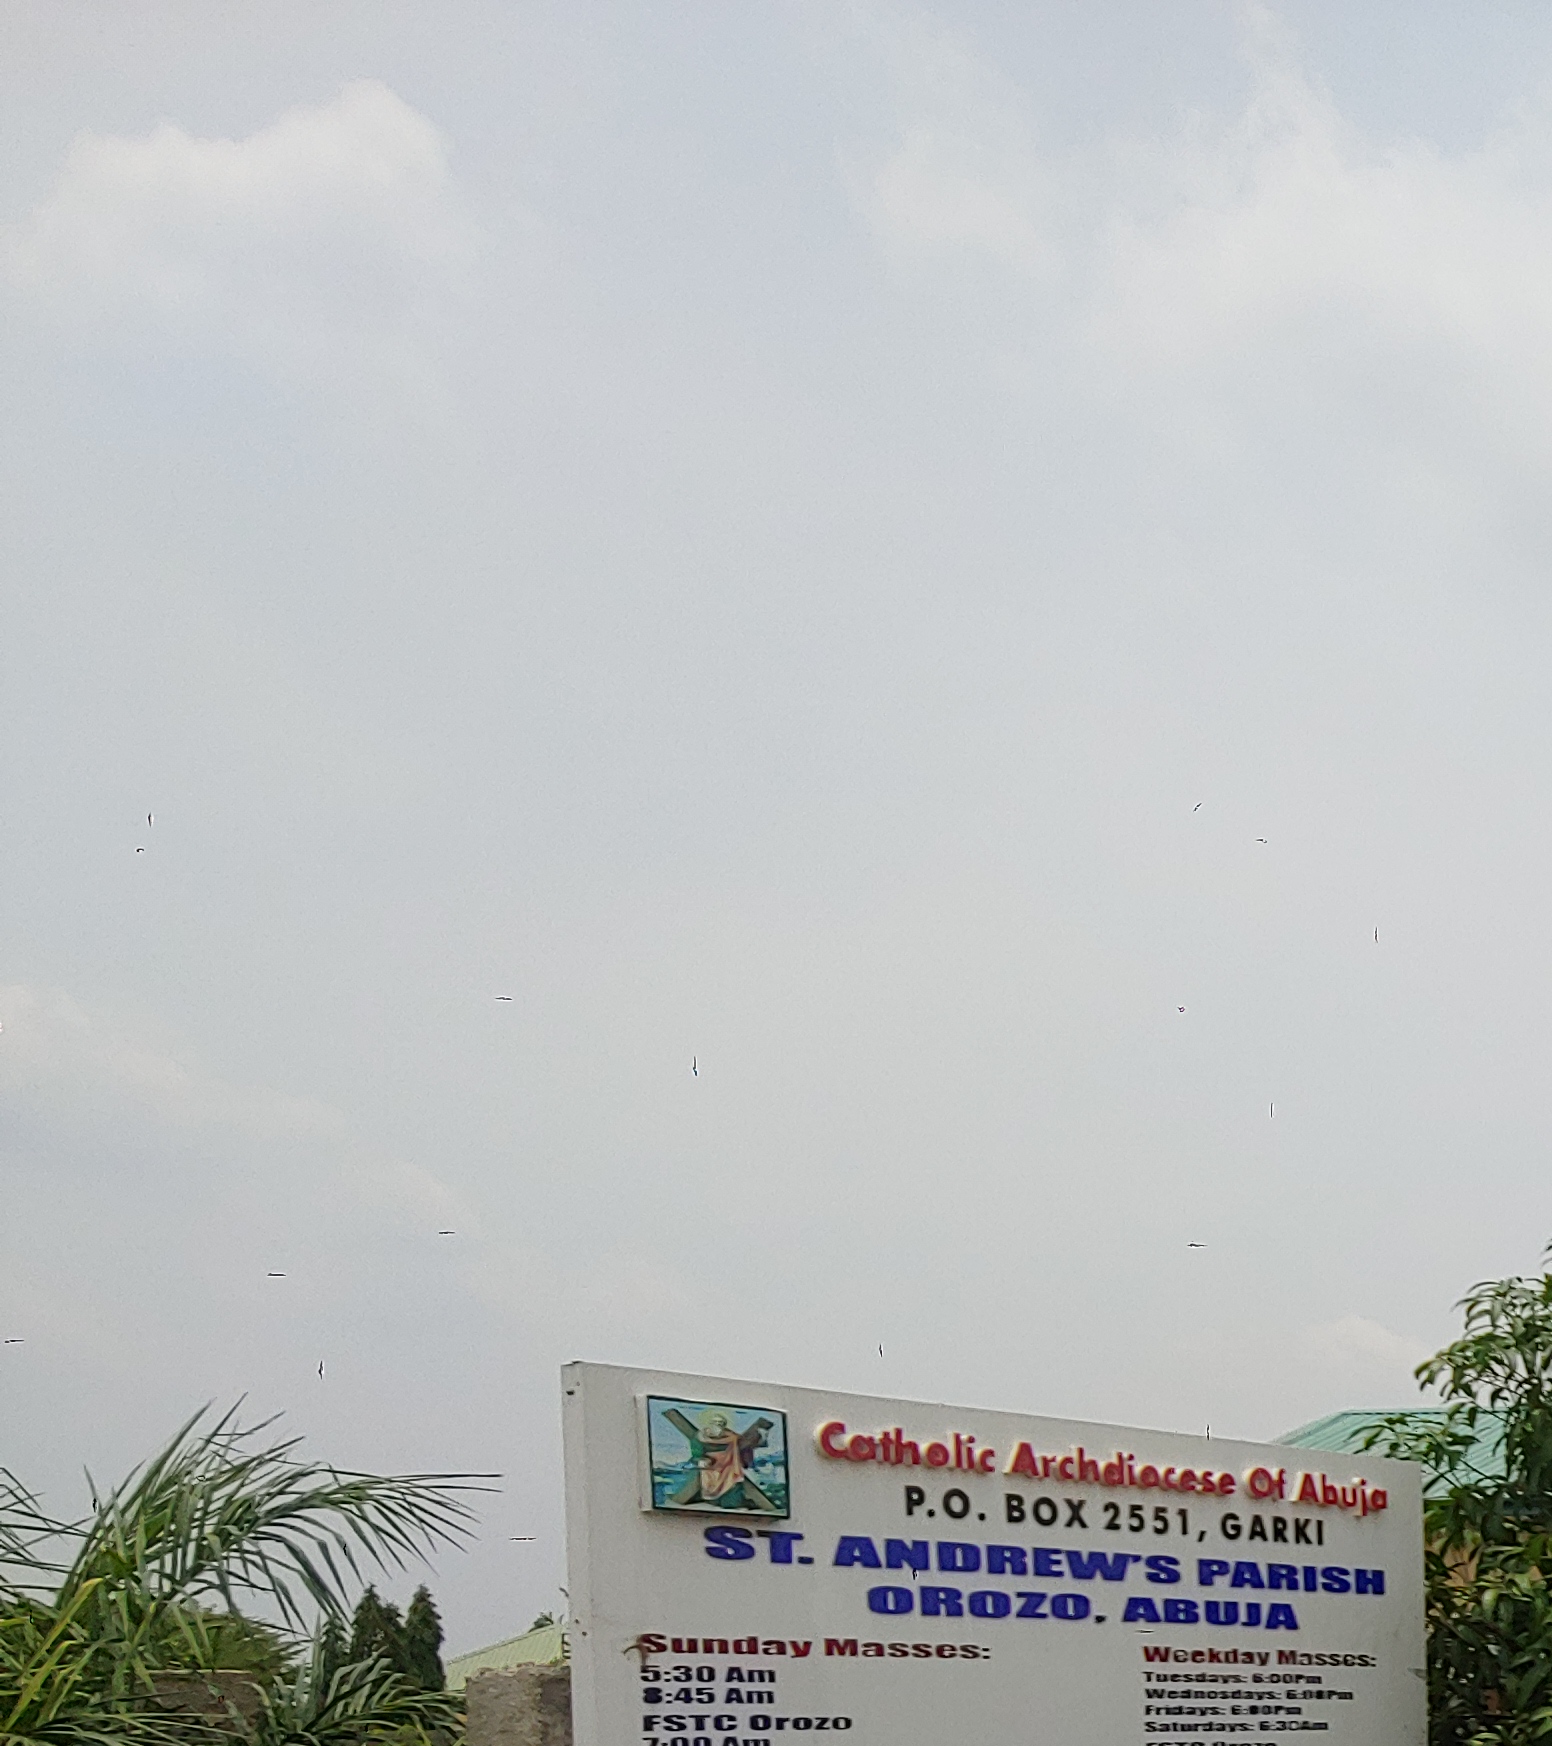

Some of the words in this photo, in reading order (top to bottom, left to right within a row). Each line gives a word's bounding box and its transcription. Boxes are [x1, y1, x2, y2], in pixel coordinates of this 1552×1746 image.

[818, 1421, 996, 1474] Catholic
[1004, 1441, 1236, 1496] Archdiocese
[1247, 1467, 1286, 1499] Of
[1296, 1472, 1388, 1517] Abuja
[904, 1485, 987, 1521] P.O.
[1005, 1493, 1089, 1529] BOX
[1103, 1501, 1207, 1543] 2551,
[1221, 1512, 1325, 1546] GARKI
[703, 1525, 815, 1565] ST.
[832, 1535, 1182, 1584] ANDREW'S
[1197, 1558, 1386, 1596] PARISH
[1122, 1597, 1300, 1631] ABUJA
[639, 1633, 813, 1659] Sunday
[823, 1638, 992, 1660] Masses:
[1143, 1646, 1271, 1666] Weekday
[1276, 1649, 1378, 1668] Masses:
[640, 1665, 716, 1684] 5:30
[725, 1666, 777, 1684] Am
[1142, 1671, 1249, 1685] Tuesdays:
[642, 1687, 716, 1705] 8:45
[724, 1687, 776, 1705] Am
[1145, 1704, 1227, 1716] Fridays:
[642, 1714, 739, 1732] FSTC
[749, 1715, 853, 1732] Orozo
[1144, 1720, 1256, 1733] Saturdays:
